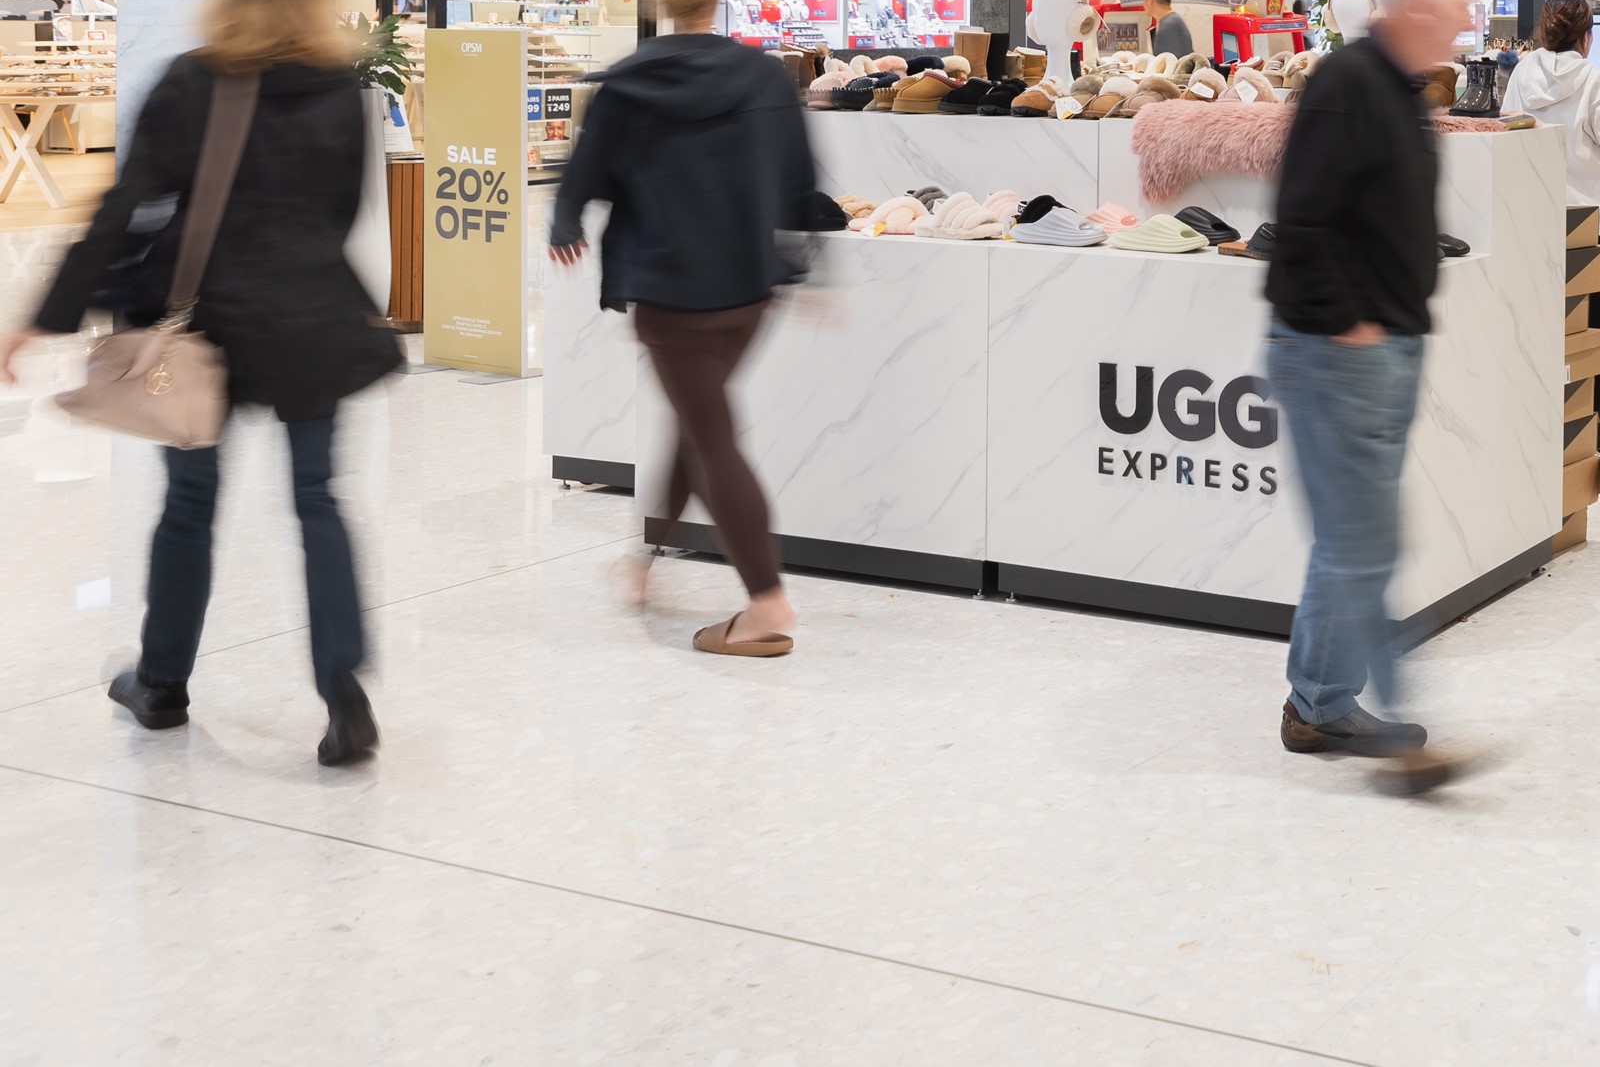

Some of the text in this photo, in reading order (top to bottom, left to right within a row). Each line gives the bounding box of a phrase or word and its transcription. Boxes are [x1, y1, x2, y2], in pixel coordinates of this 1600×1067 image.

[461, 42, 483, 53] OPSM
[552, 94, 570, 102] PAIRS
[447, 145, 497, 166] SALE
[435, 166, 509, 205] 20%
[1098, 362, 1278, 449] UGG
[1098, 446, 1278, 495] EXPRESS
